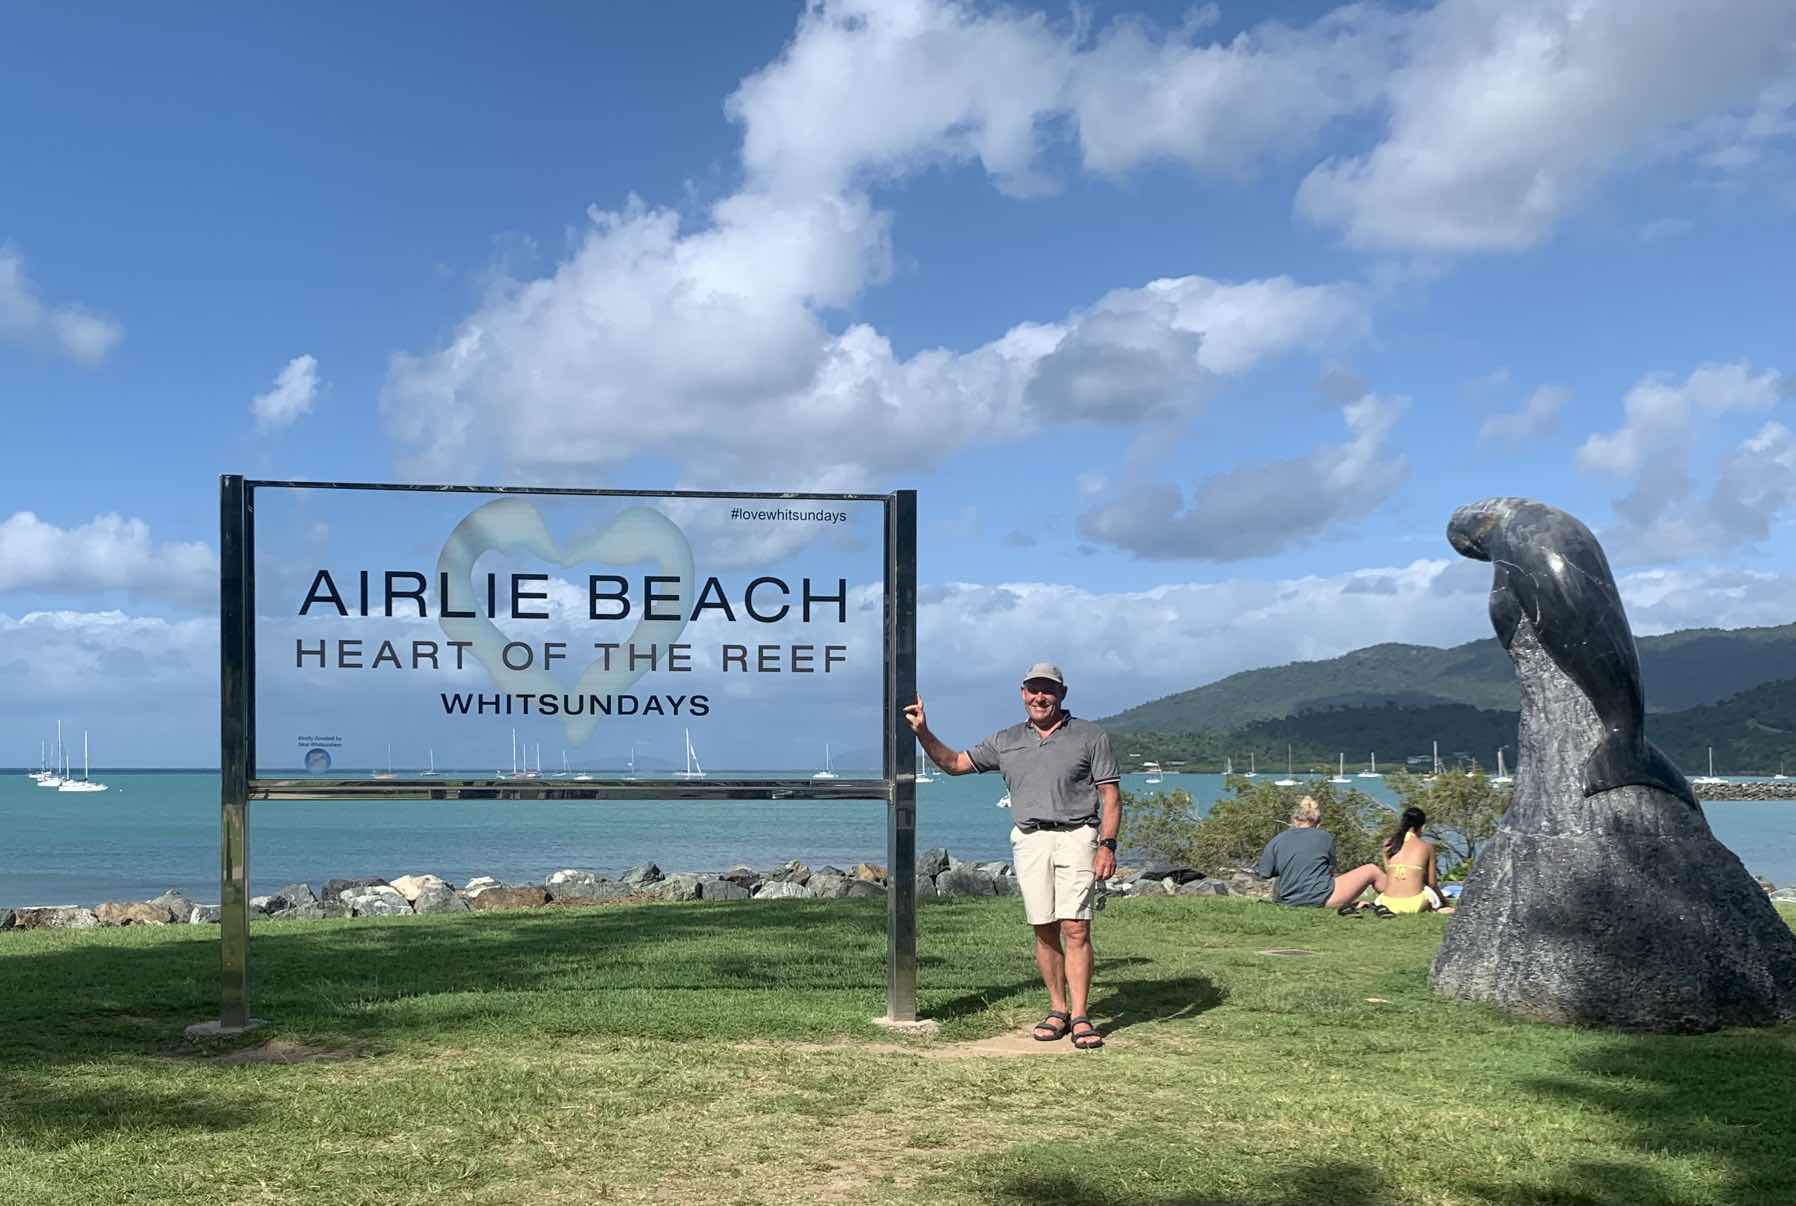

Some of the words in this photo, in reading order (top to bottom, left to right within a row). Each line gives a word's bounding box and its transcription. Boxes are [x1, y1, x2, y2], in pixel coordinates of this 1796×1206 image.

[731, 507, 847, 524] #lovewhitsundays
[298, 569, 550, 620] AIRLIE
[589, 574, 847, 624] BEACH
[296, 639, 473, 671] HEART
[502, 641, 568, 671] OF
[594, 643, 692, 672] THE
[722, 644, 847, 673] REEF
[441, 693, 710, 717] WHITSUNDAYS
